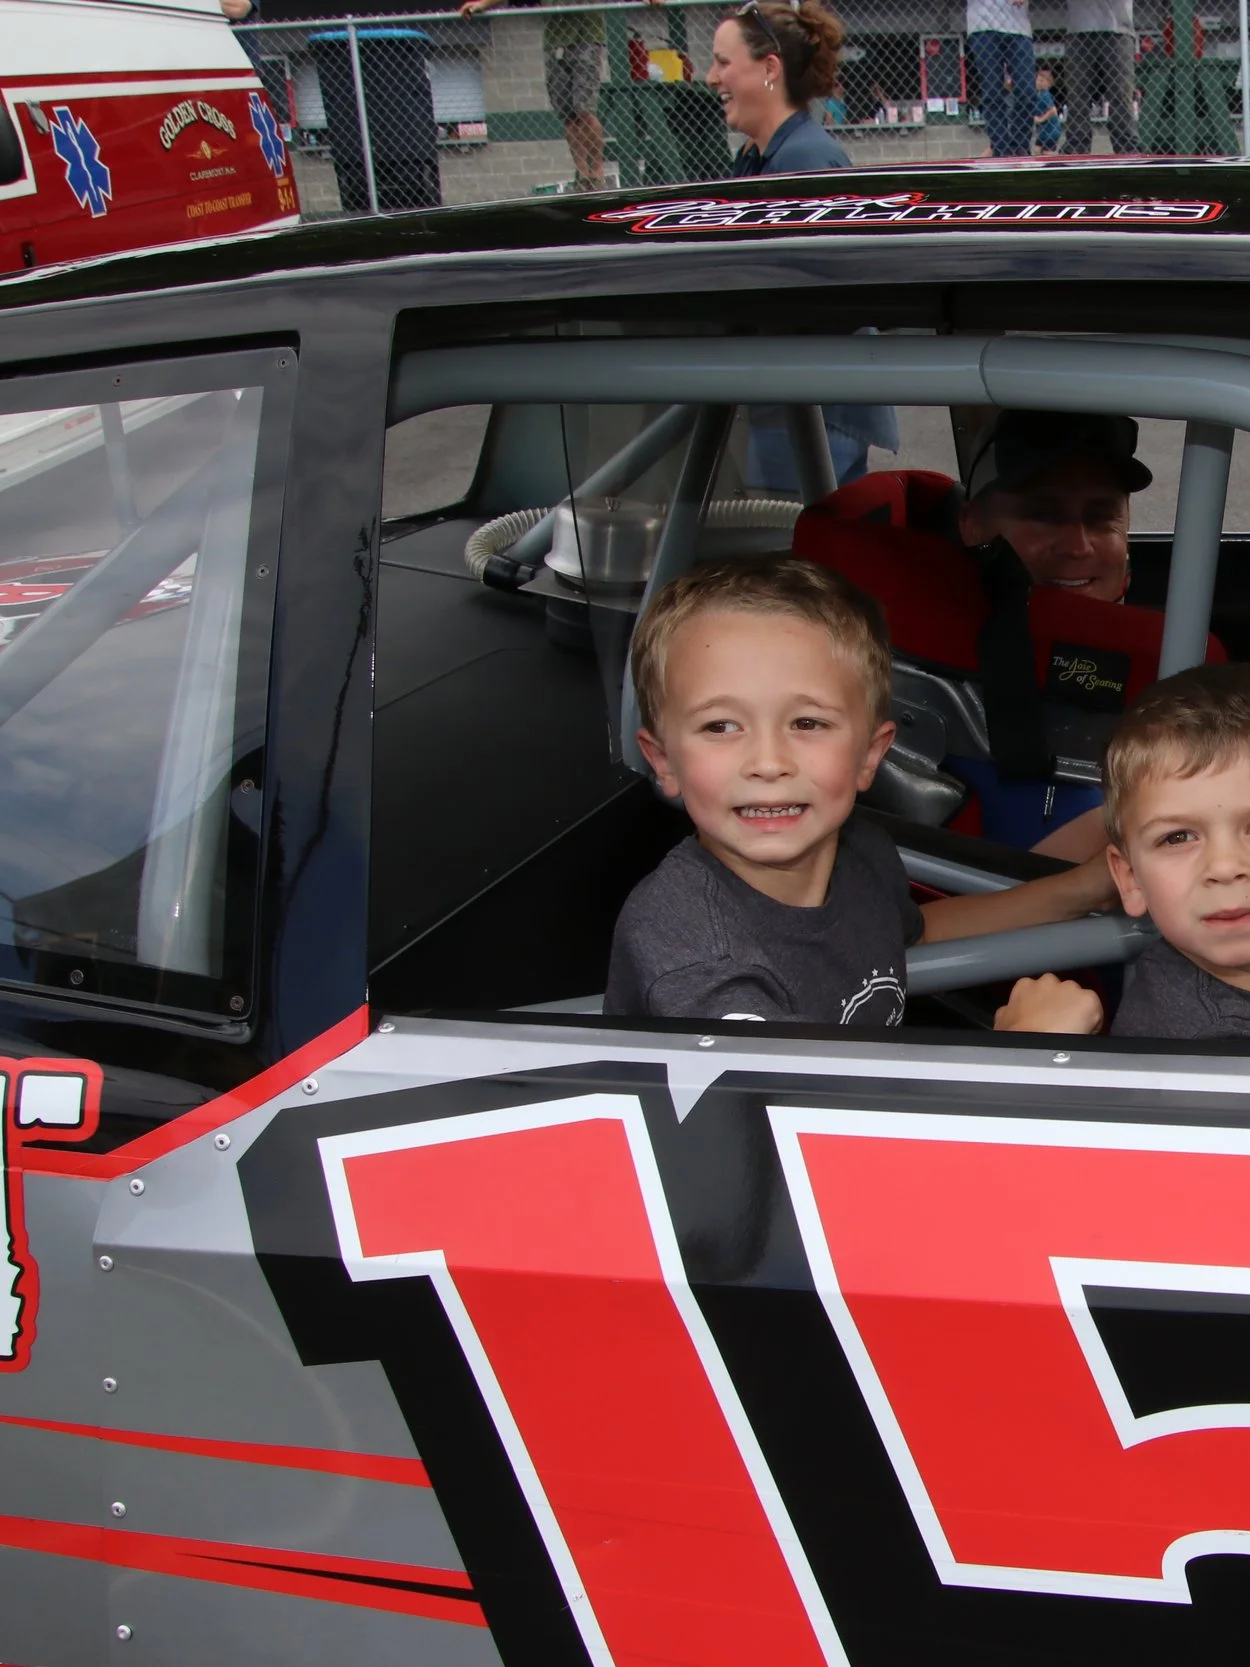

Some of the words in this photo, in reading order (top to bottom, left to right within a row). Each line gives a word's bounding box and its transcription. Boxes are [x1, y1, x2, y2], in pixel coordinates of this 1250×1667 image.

[159, 100, 199, 150] GOLDEN
[197, 100, 237, 140] CROSS
[1053, 656, 1070, 667] The
[1076, 674, 1088, 684] of
[1085, 674, 1123, 691] Seating
